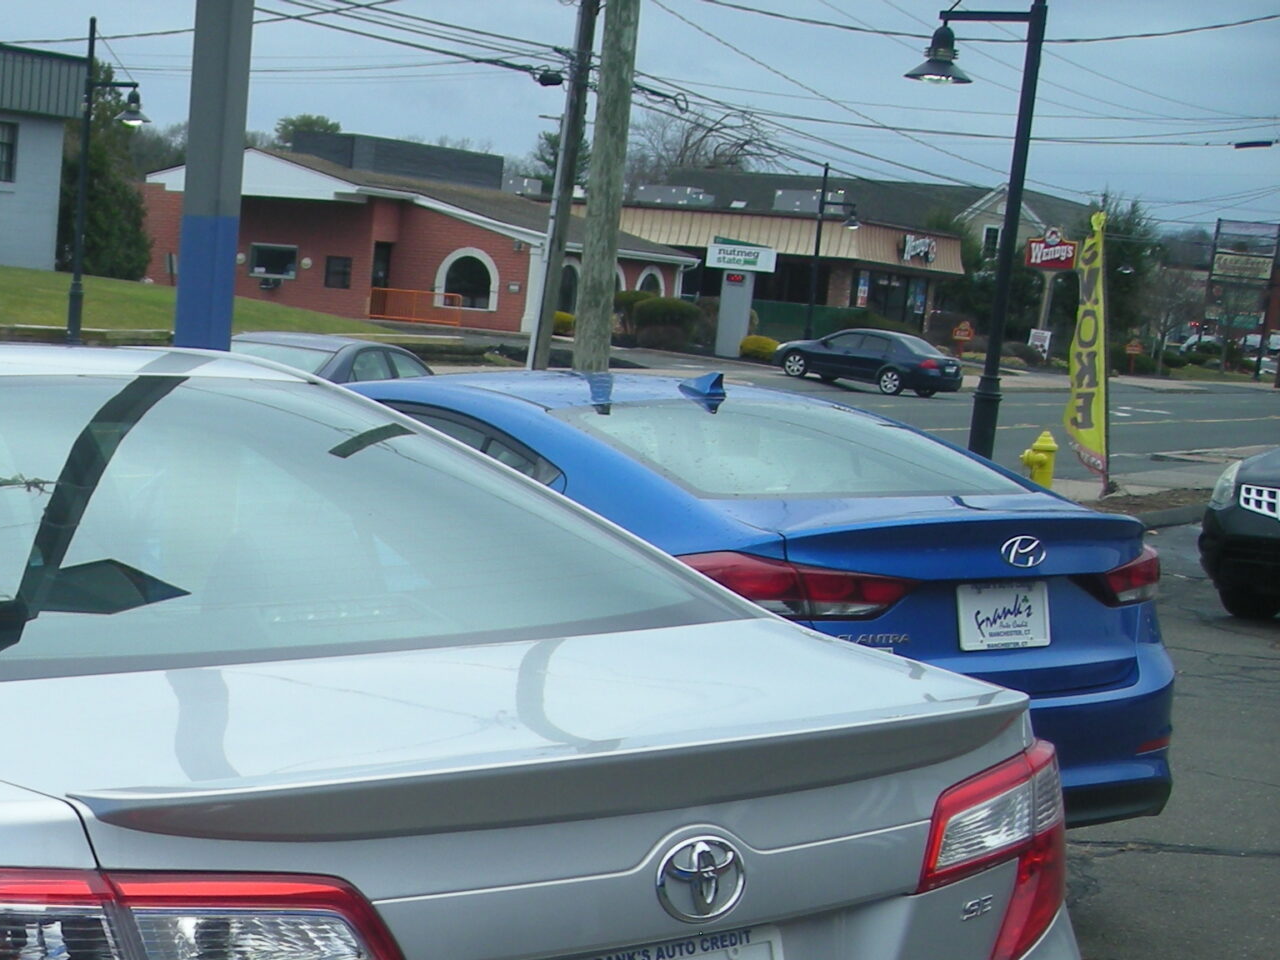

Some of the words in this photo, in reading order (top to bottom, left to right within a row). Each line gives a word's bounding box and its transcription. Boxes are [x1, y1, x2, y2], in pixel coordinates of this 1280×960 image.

[716, 256, 742, 265] state
[718, 247, 760, 259] nutmeg
[963, 894, 993, 920] SE
[655, 940, 696, 960] AUTO
[700, 930, 752, 952] CREDIT
